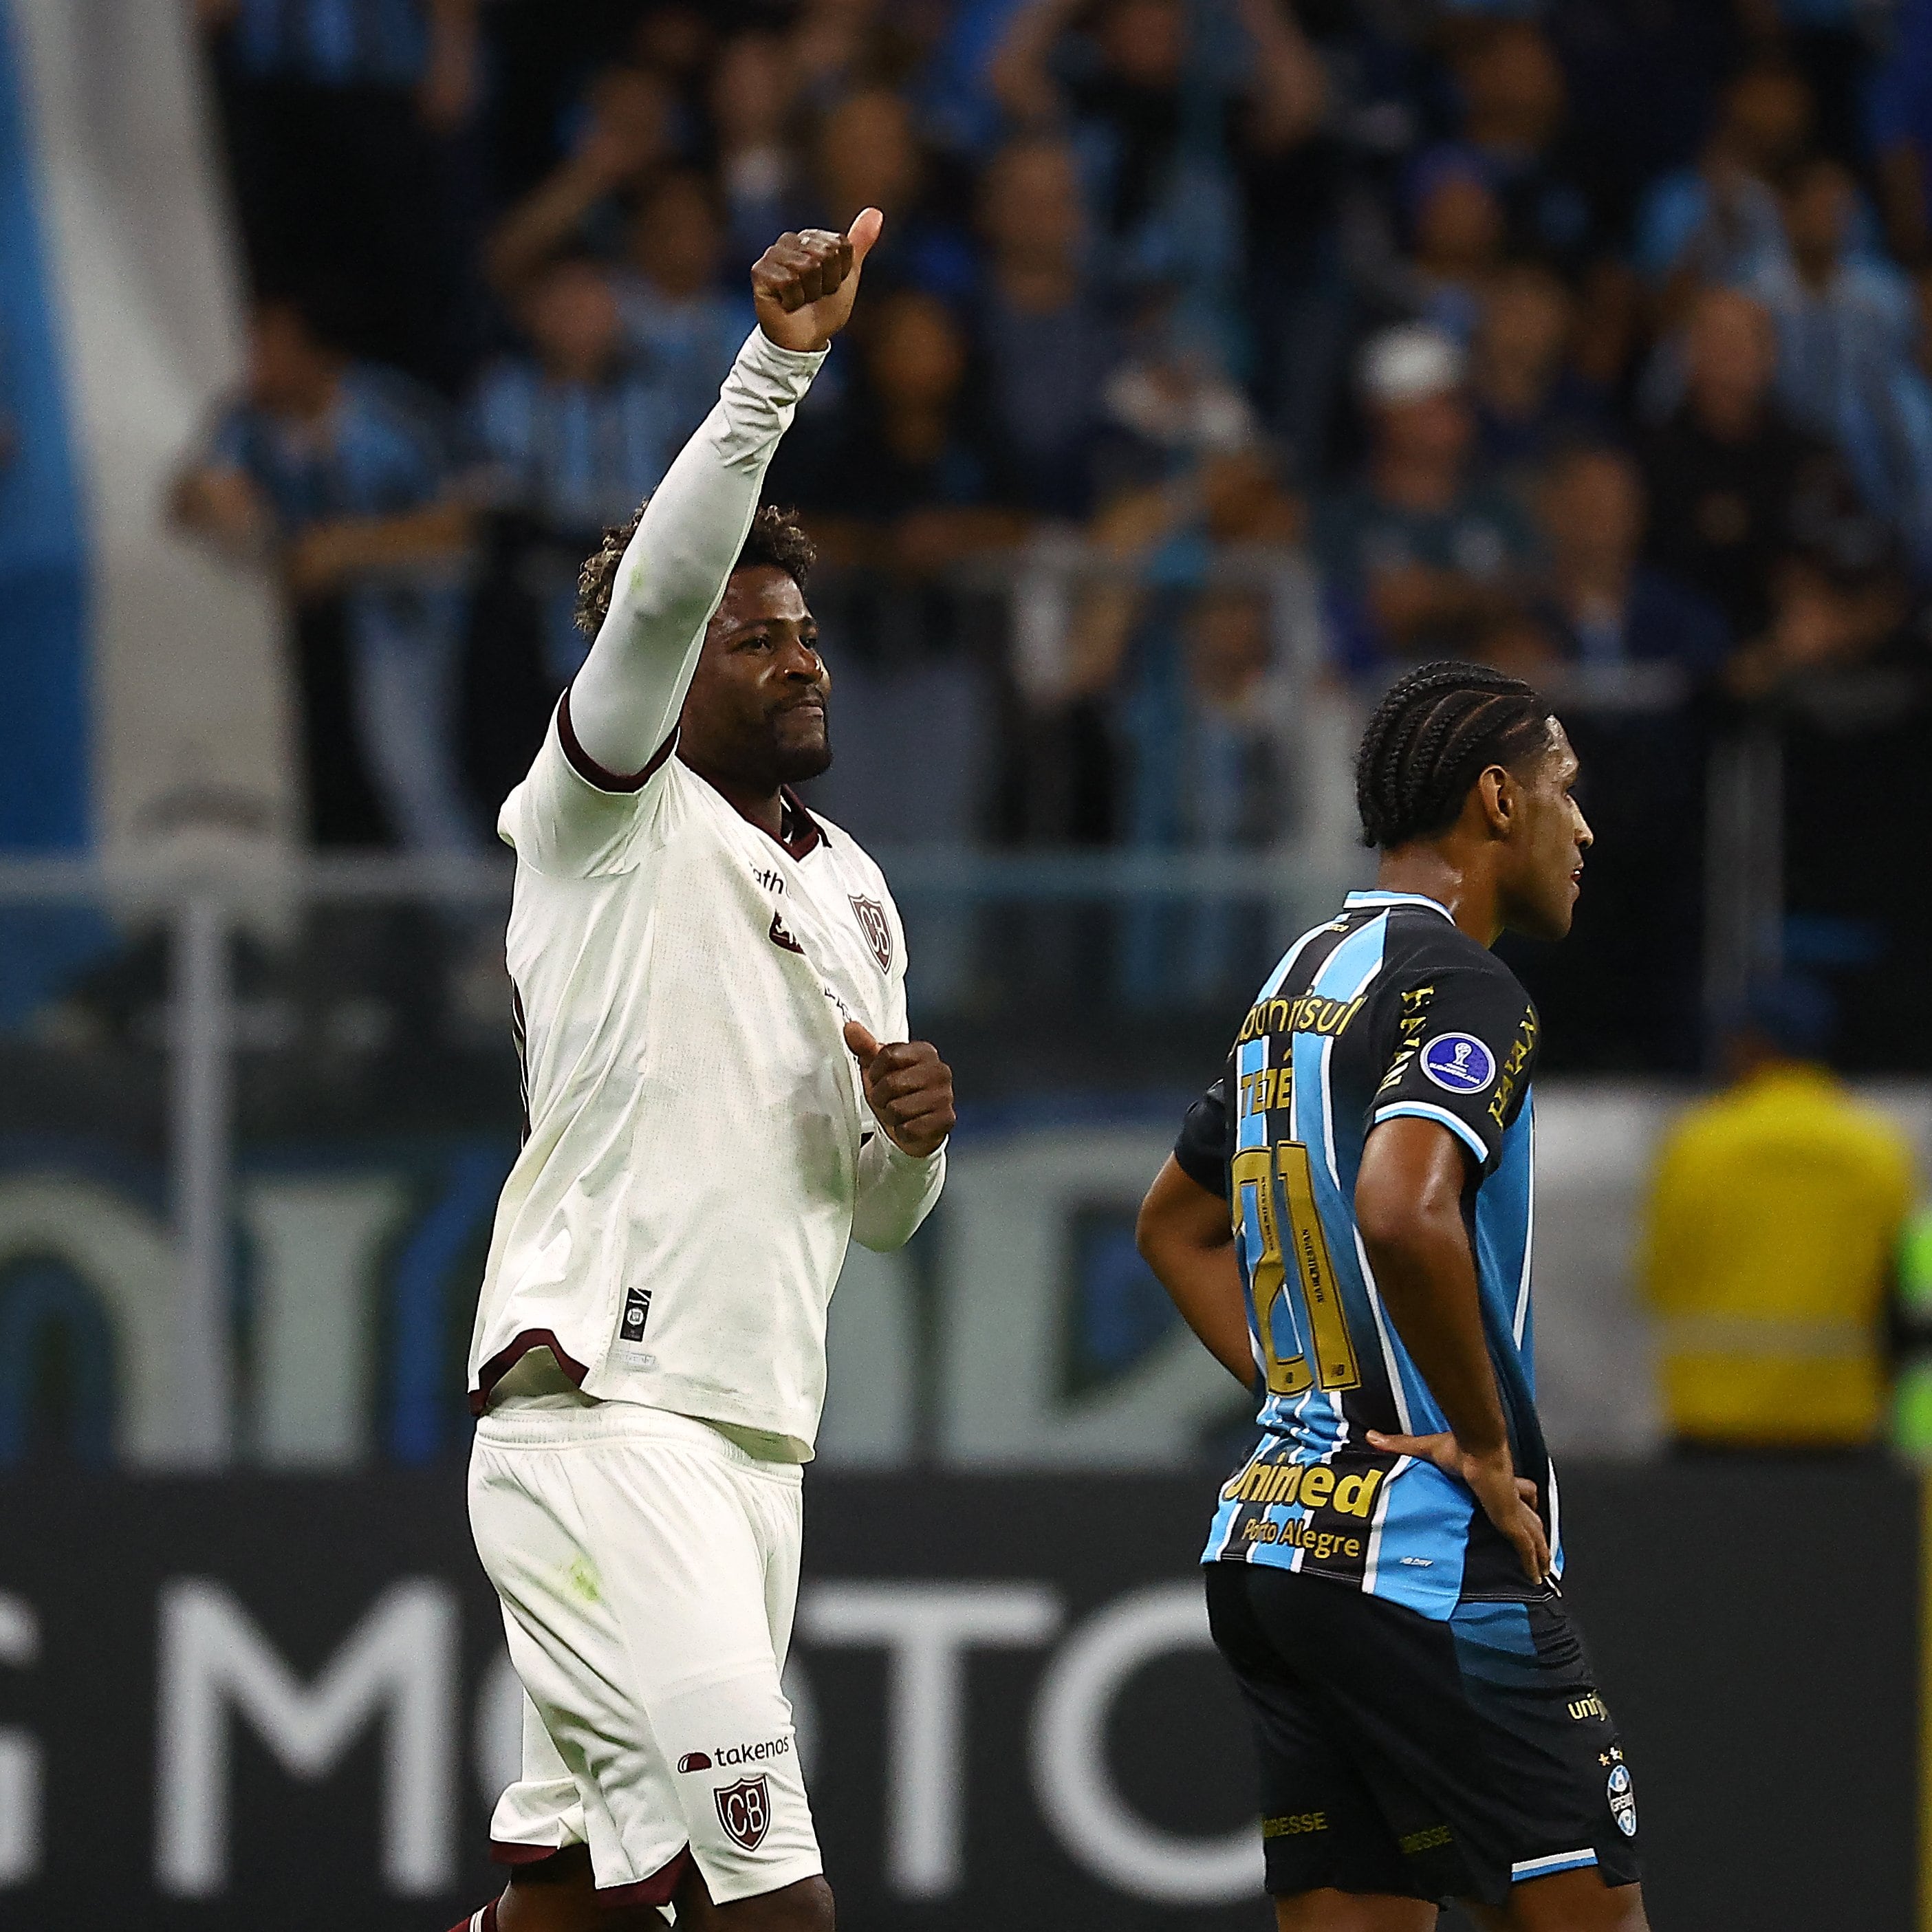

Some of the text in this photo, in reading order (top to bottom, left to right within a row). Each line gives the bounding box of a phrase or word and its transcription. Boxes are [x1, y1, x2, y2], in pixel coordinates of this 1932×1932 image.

[1279, 1520, 1360, 1559] Alegre
[714, 1736, 790, 1767] takenos
[727, 1788, 764, 1837] CB
